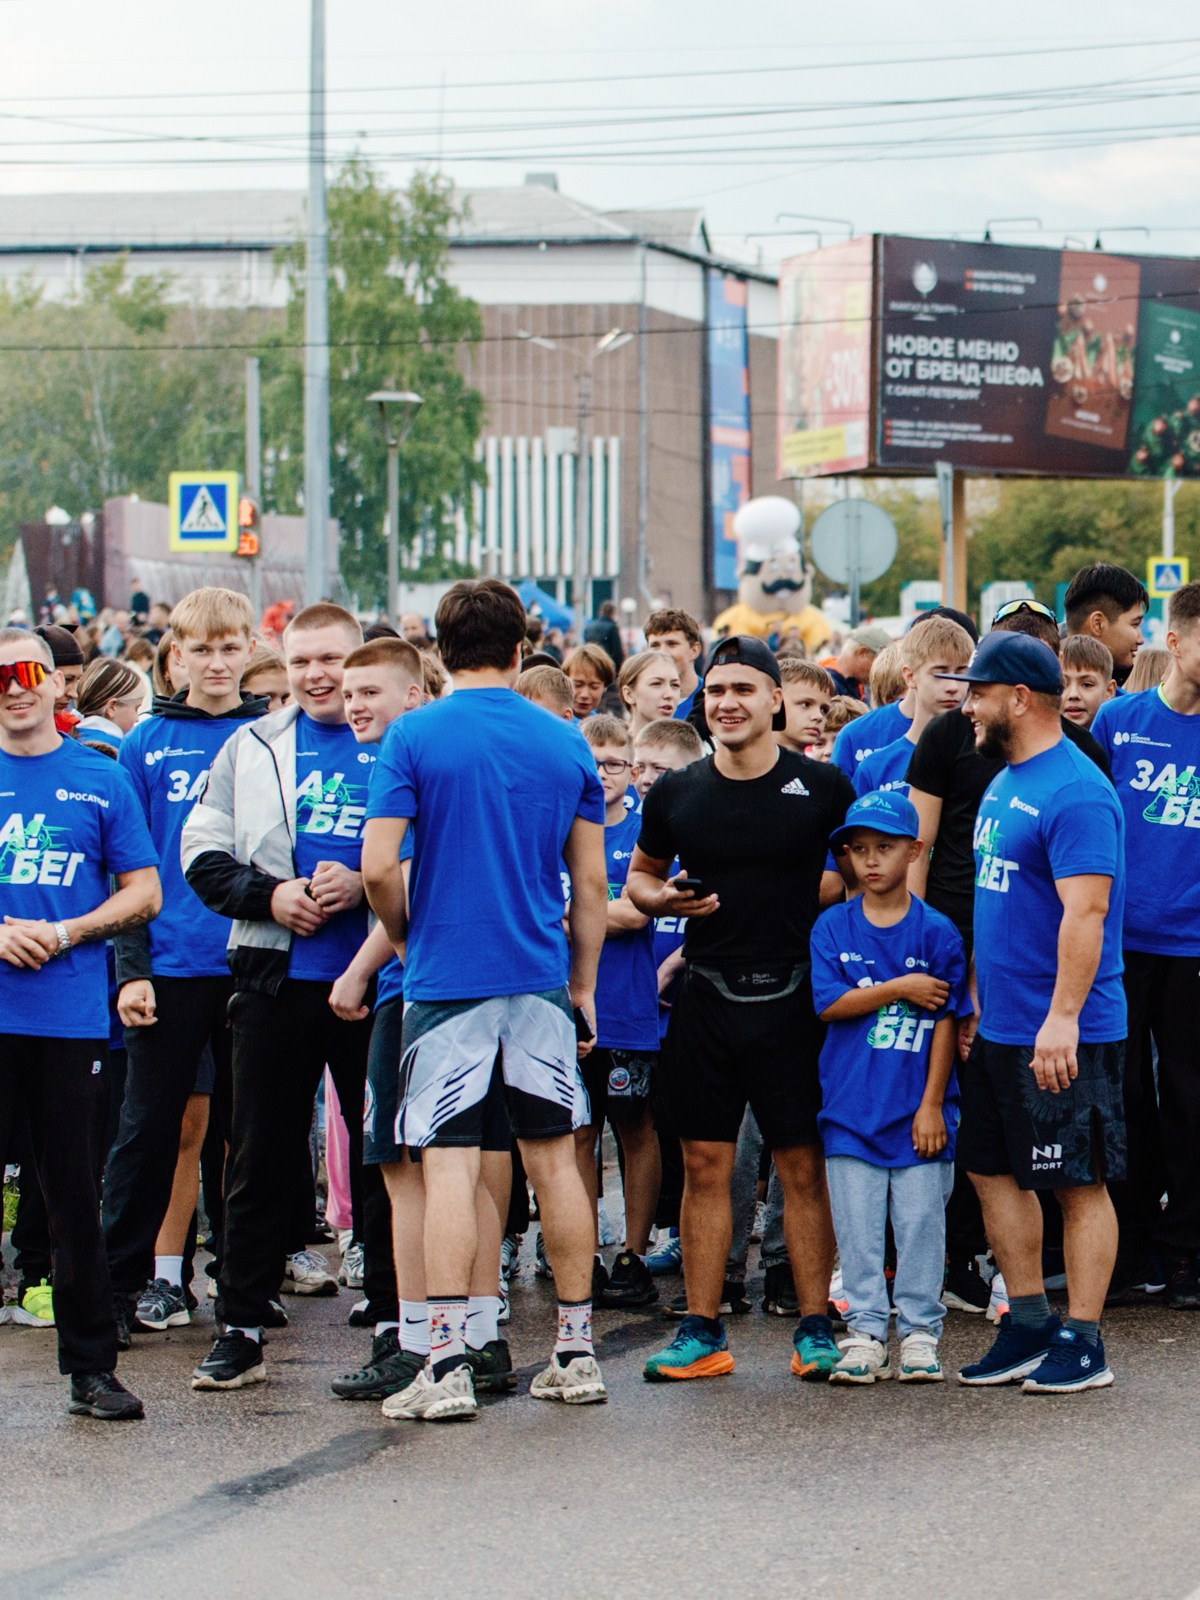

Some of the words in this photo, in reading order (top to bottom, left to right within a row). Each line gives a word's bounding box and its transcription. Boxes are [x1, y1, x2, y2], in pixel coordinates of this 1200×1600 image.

[886, 334, 956, 359] НОВОЕ
[957, 339, 1020, 363] МЕНЮ
[885, 357, 914, 379] ОТ
[915, 360, 1045, 388] БРЕНД-ШЕФА
[167, 770, 211, 802] ЗА
[296, 770, 346, 803] А!
[781, 787, 810, 797] adidas
[1129, 759, 1197, 795] ЗА!
[0, 813, 46, 848] А!
[10, 850, 85, 887] БЕГ
[976, 854, 1020, 893] БЕГ
[873, 1016, 935, 1053] БЕГ
[1032, 1162, 1063, 1170] SPORT
